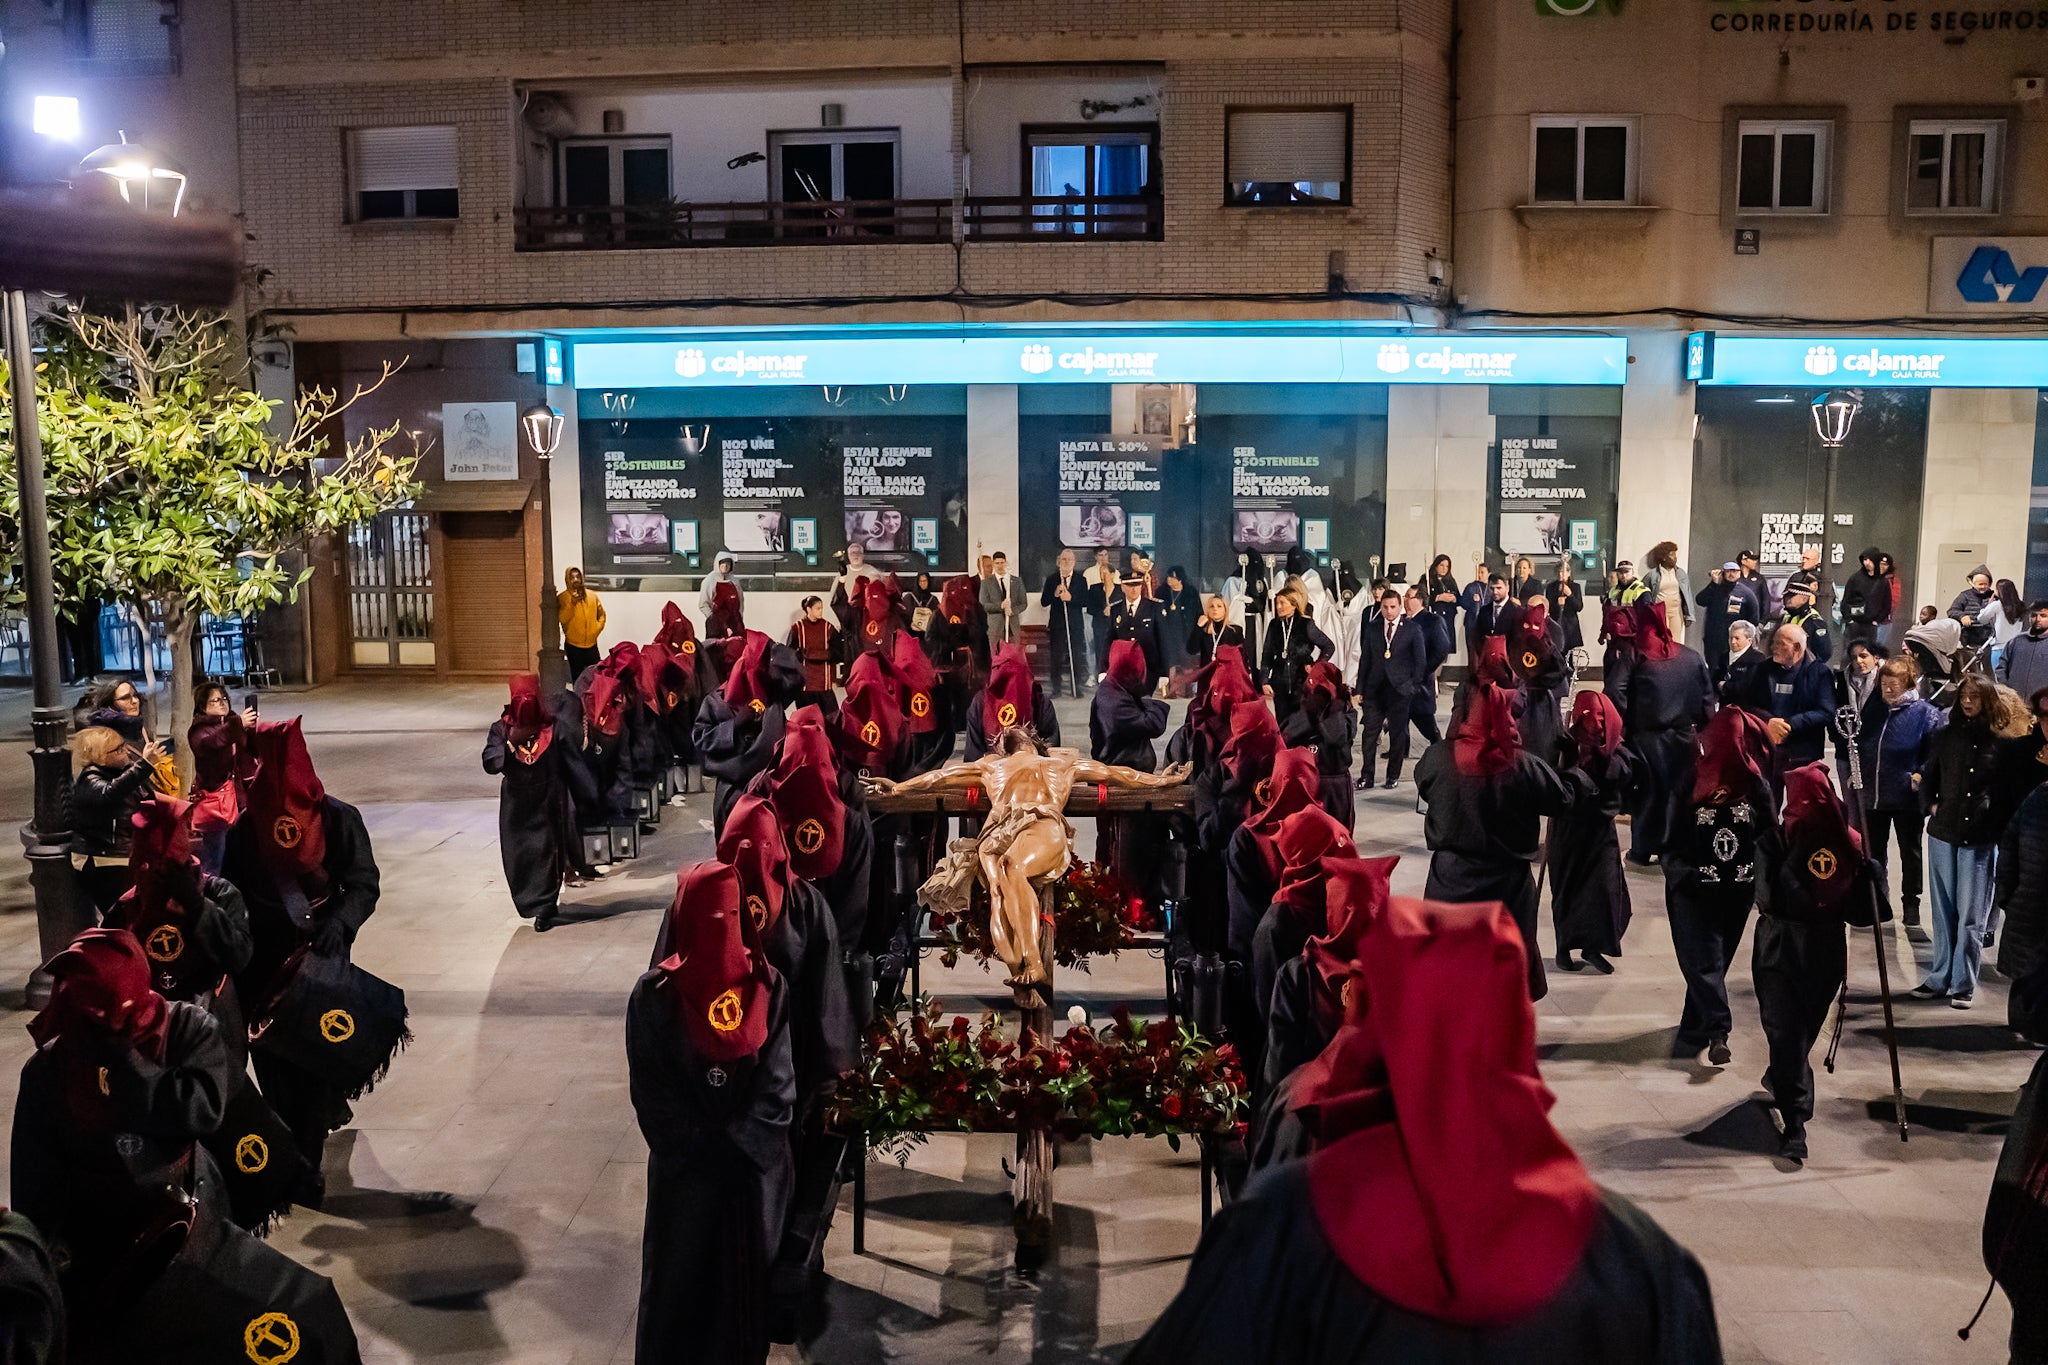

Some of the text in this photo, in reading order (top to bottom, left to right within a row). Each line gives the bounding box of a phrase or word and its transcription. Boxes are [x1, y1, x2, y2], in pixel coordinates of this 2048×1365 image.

[1710, 9, 2048, 32] CORREDURÍA DE SEGUROS
[711, 350, 808, 378] cajamar
[1058, 346, 1159, 375] cajamar
[1415, 346, 1517, 375] cajamar
[1843, 348, 1945, 377] cajamar
[722, 439, 775, 450] NOS UNE
[1060, 441, 1148, 452] HASTA EL 30%
[1502, 439, 1557, 449] NOS UNE
[604, 451, 625, 461] SER
[722, 449, 744, 459] SER
[843, 447, 932, 457] ESTAR SIEMPRE
[1060, 451, 1076, 462] DE
[1233, 447, 1256, 457] SER
[1502, 449, 1524, 459] SER
[722, 458, 794, 469] DISTINTOS...
[843, 456, 907, 467] A TU LADO
[1501, 458, 1576, 469] DISTINTOS...
[450, 464, 479, 473] John
[723, 468, 776, 478] NOS UNE
[843, 466, 877, 476] PARA
[1501, 468, 1557, 479] NOS UNE
[843, 475, 926, 486] HACER BANCA
[1060, 470, 1135, 481] VEN AL CLUB
[1233, 475, 1311, 486] EMPEZANDO
[605, 479, 678, 490] EMPEZANDO
[723, 478, 745, 488] SER
[1060, 480, 1161, 491] DE LOS SEGUROS
[1501, 478, 1524, 488] SER
[605, 488, 697, 499] POR NOSOTROS
[723, 487, 805, 498] COOPERATIVA
[843, 485, 925, 496] DE PERSONAS
[1233, 485, 1330, 496] POR NOSOTROS
[1501, 487, 1586, 498] COOPERATIVA
[1762, 513, 1800, 525] ESTAR
[1761, 523, 1824, 534] A TU LADO
[1761, 532, 1796, 543] PARA
[1760, 543, 1800, 553] HACER
[1760, 552, 1777, 563] DE
